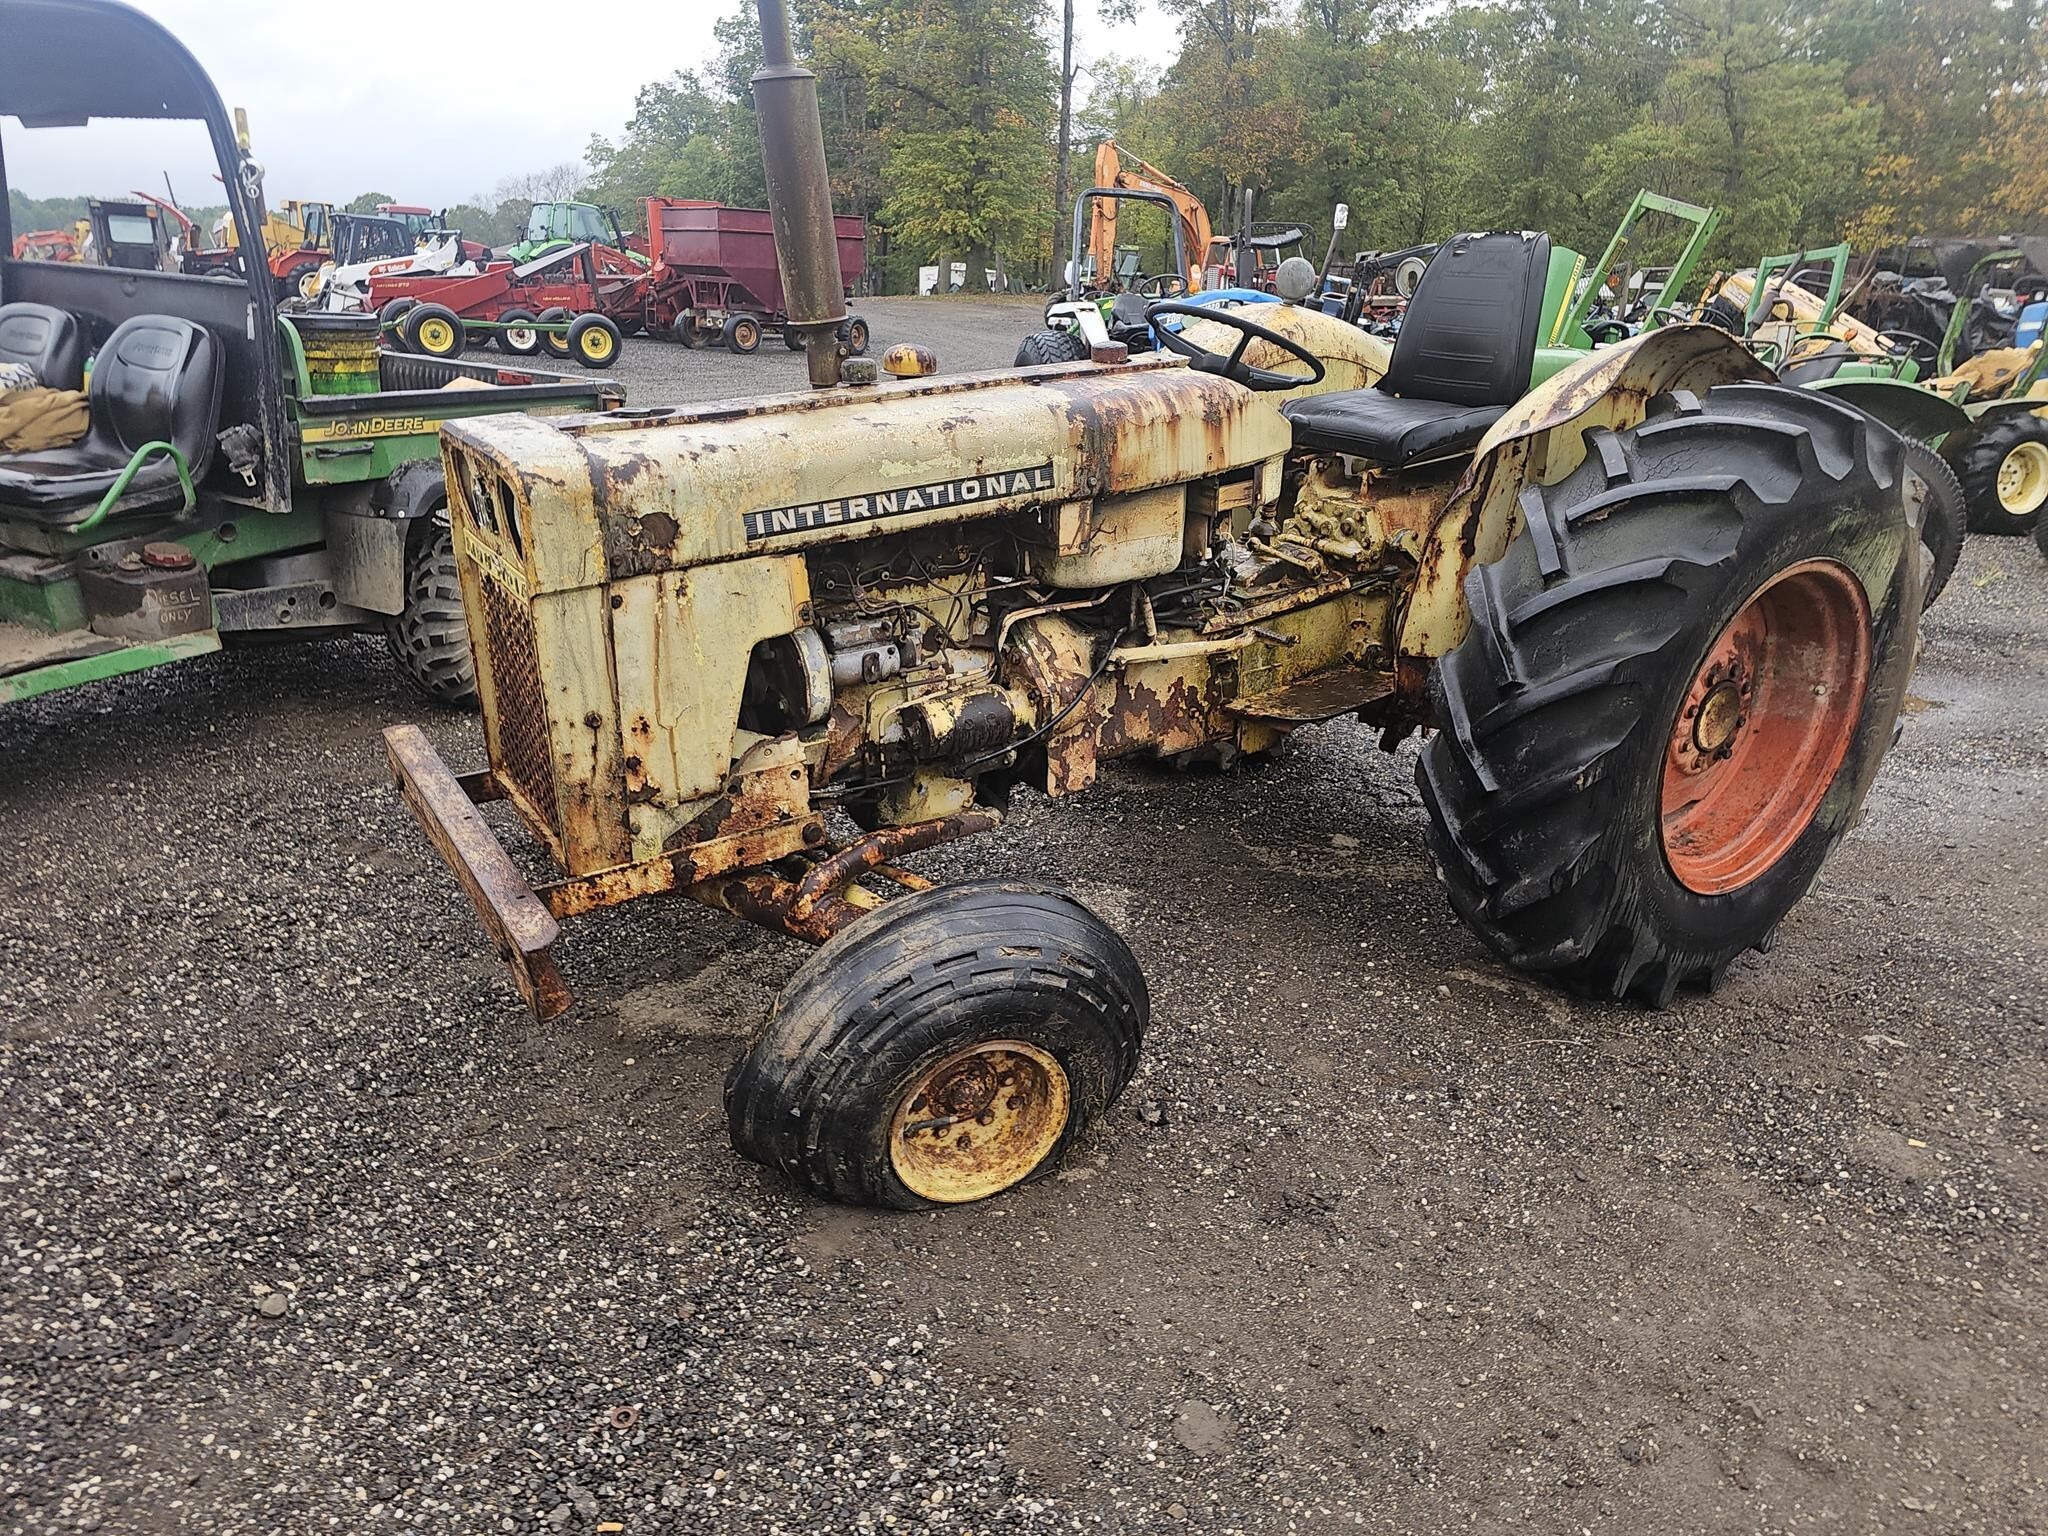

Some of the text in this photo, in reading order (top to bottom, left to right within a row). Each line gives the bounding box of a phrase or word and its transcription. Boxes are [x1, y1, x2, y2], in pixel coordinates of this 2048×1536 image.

[1166, 312, 1182, 324] FOR
[324, 416, 424, 437] JOHN DEERE
[755, 468, 1051, 535] INTERNATIONAL
[160, 609, 192, 624] ONLY
